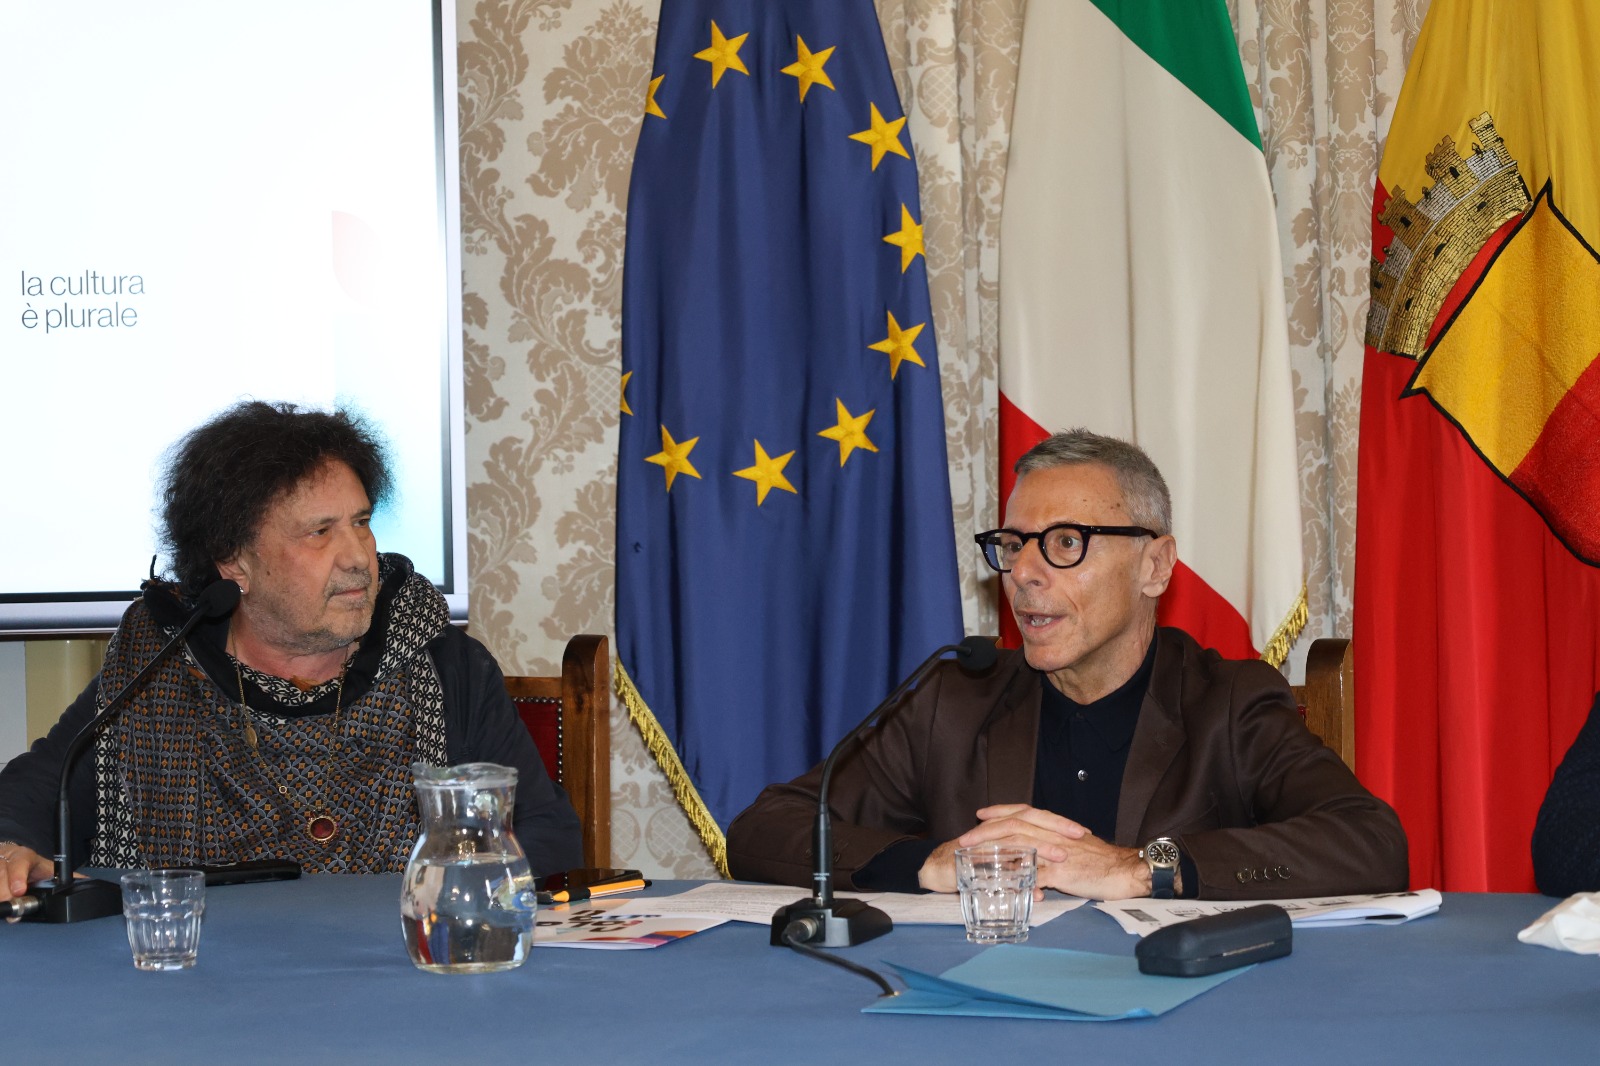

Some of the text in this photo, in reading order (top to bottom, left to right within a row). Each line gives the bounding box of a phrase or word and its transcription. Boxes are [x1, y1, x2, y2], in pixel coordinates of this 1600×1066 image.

[21, 269, 145, 296] la cultura
[21, 301, 138, 334] è plurale
